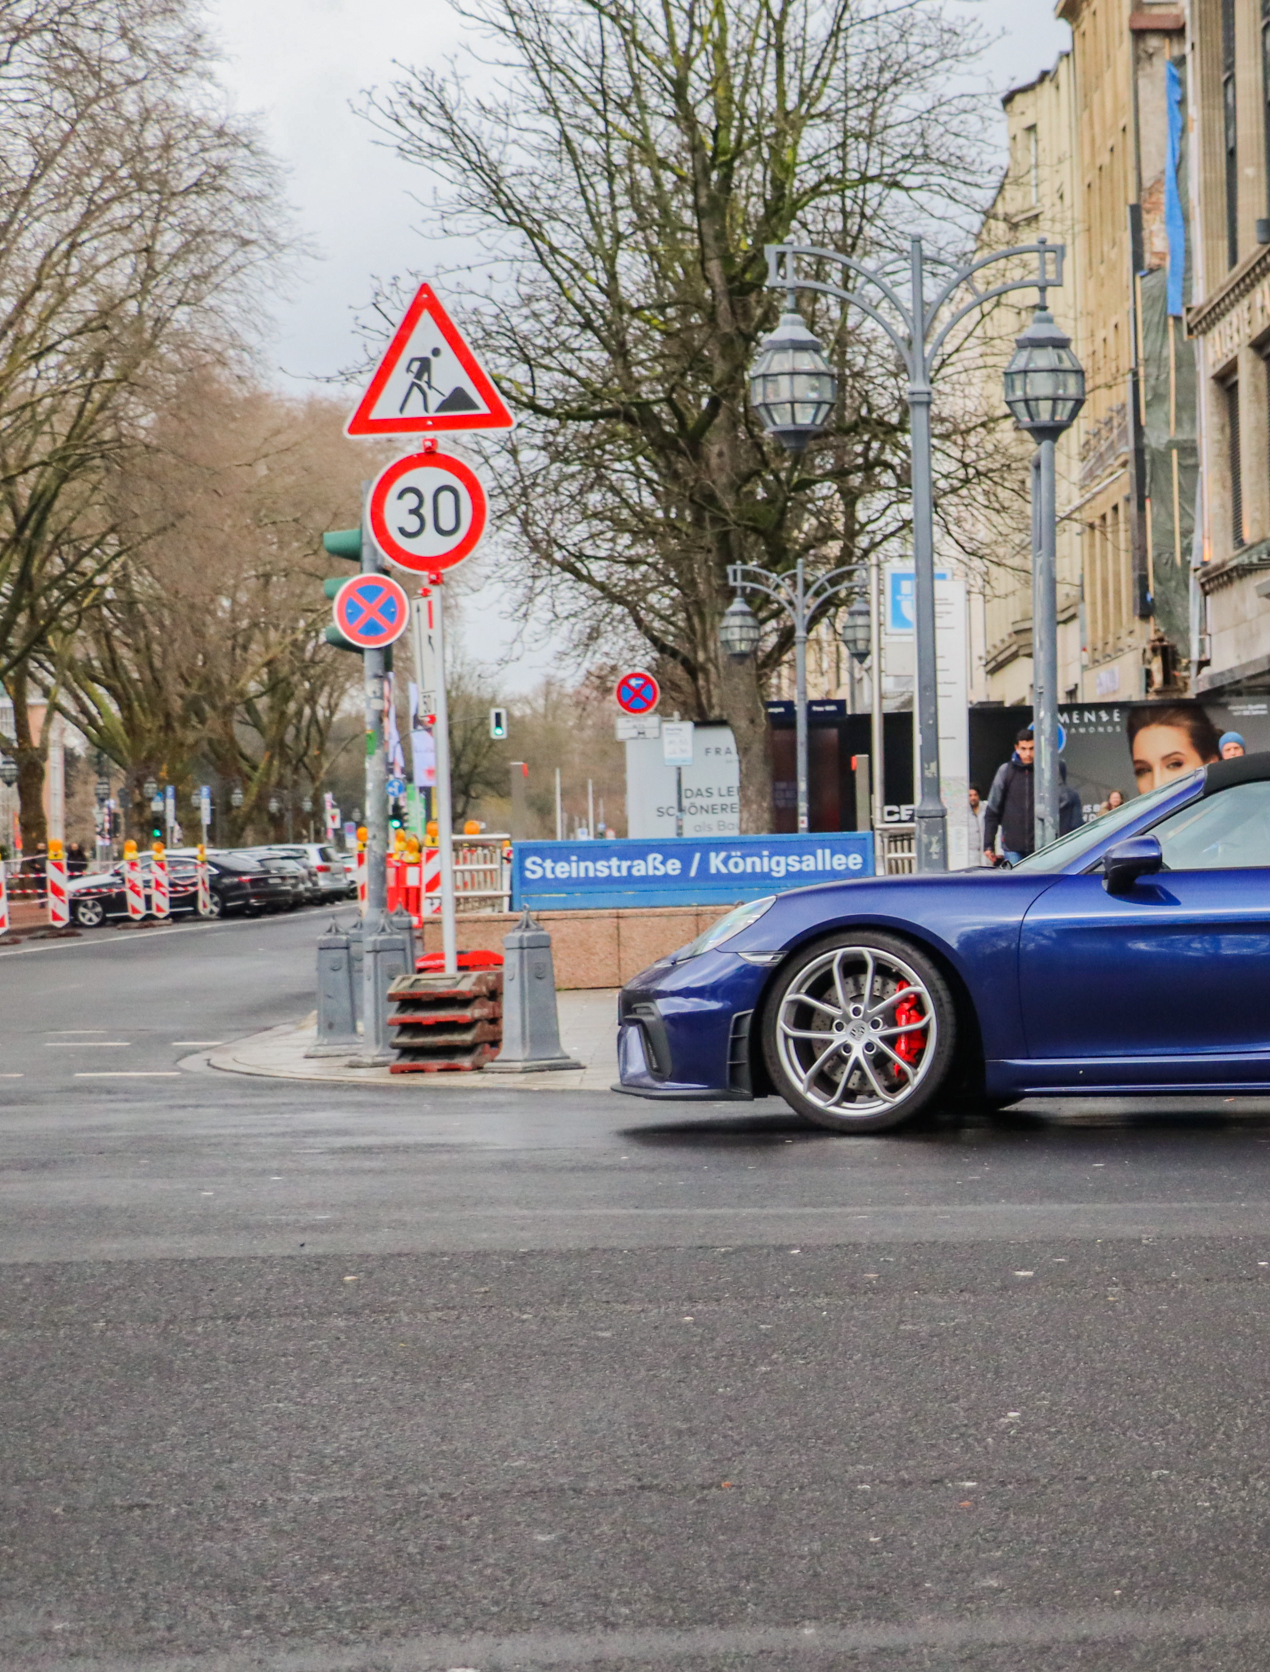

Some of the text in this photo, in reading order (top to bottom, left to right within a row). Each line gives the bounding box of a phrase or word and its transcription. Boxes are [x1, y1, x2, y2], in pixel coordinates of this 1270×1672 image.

[396, 484, 462, 539] 30
[684, 787, 714, 799] DAS
[694, 820, 713, 833] als
[523, 849, 864, 880] Steinstraße / Königsallee
